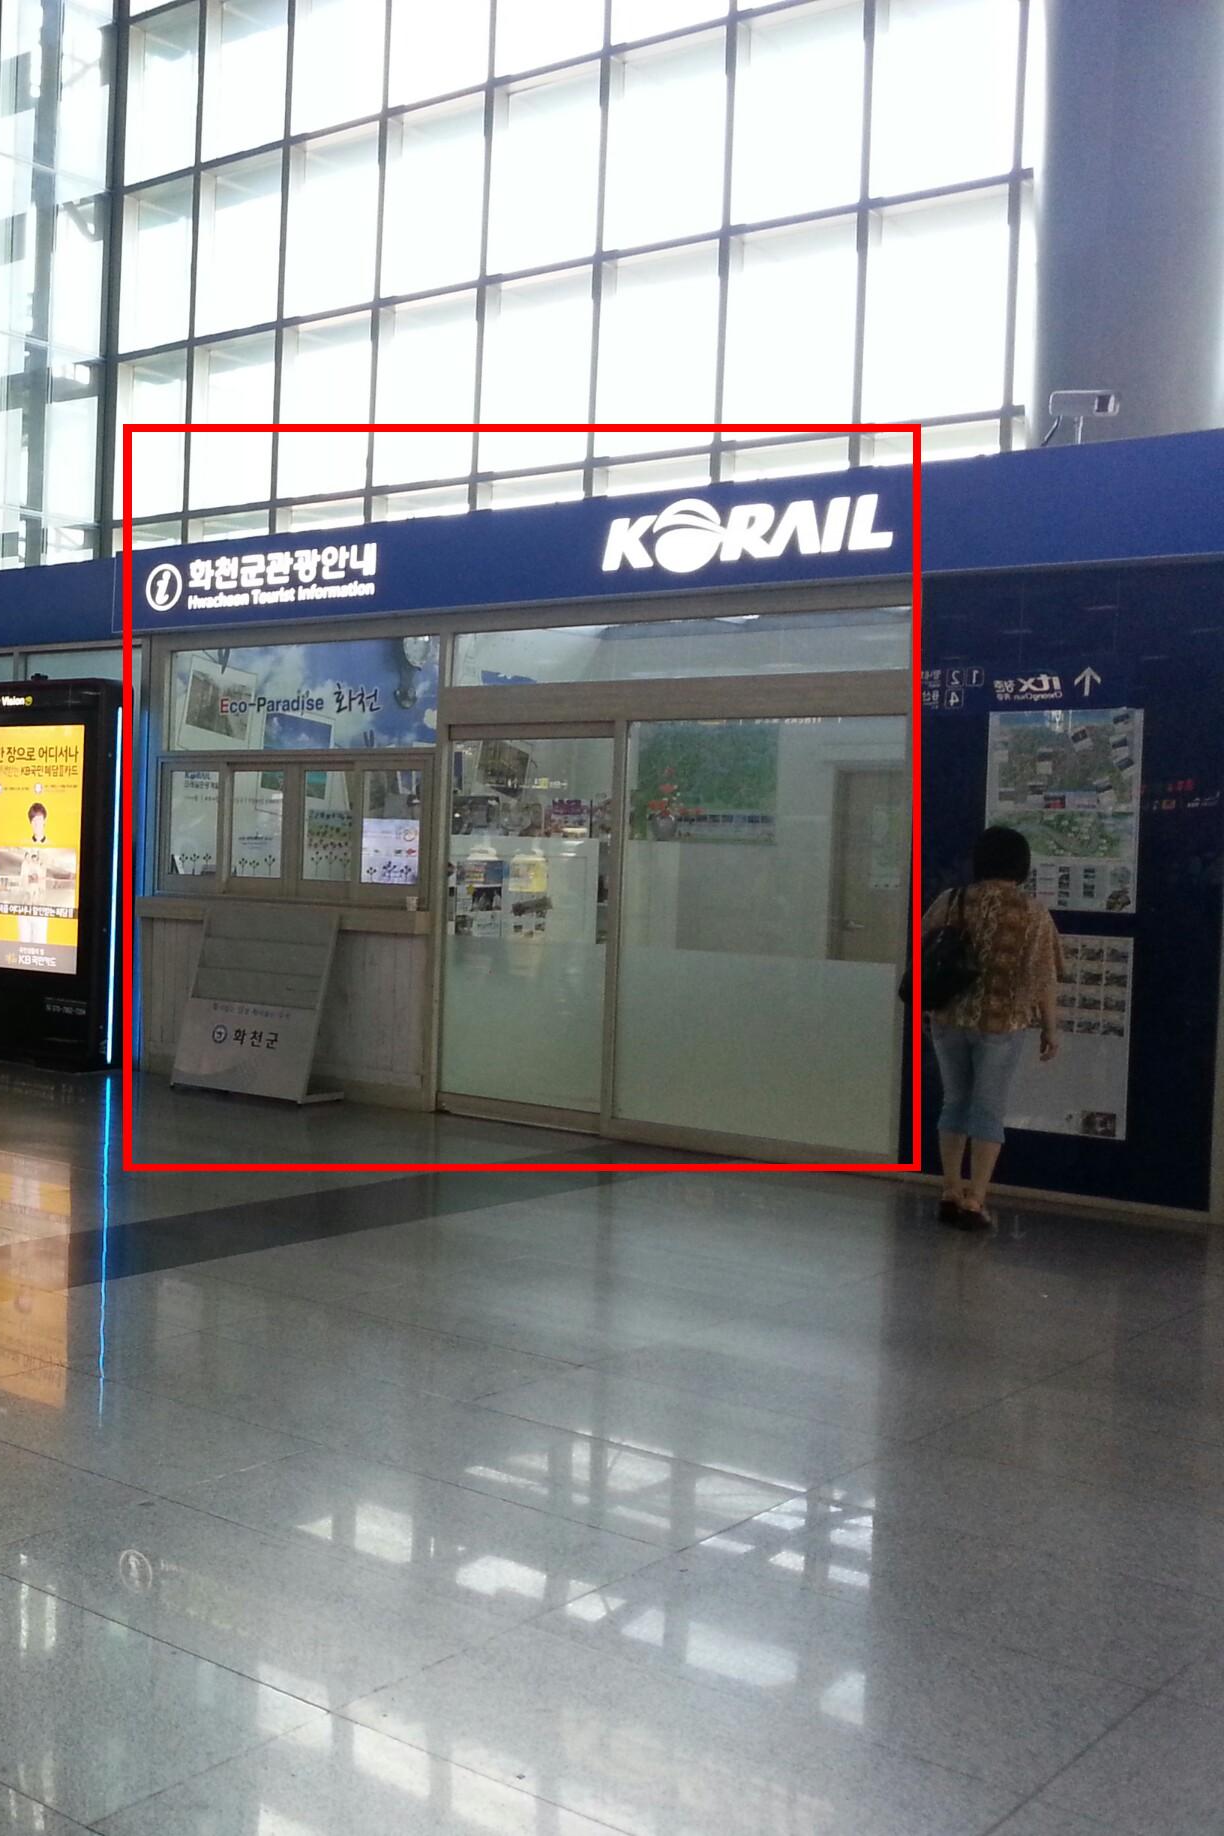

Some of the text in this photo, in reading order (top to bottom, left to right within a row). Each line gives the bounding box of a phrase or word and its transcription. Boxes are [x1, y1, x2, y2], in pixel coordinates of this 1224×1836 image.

[602, 494, 893, 573] KORAIL
[188, 543, 377, 591] 화천군관광안내
[252, 586, 295, 605] Tourist
[298, 581, 375, 601] Information
[220, 682, 381, 714] Eco-Paradise 화천
[38, 745, 79, 763] 어디서나
[233, 1028, 279, 1050] 화천군
